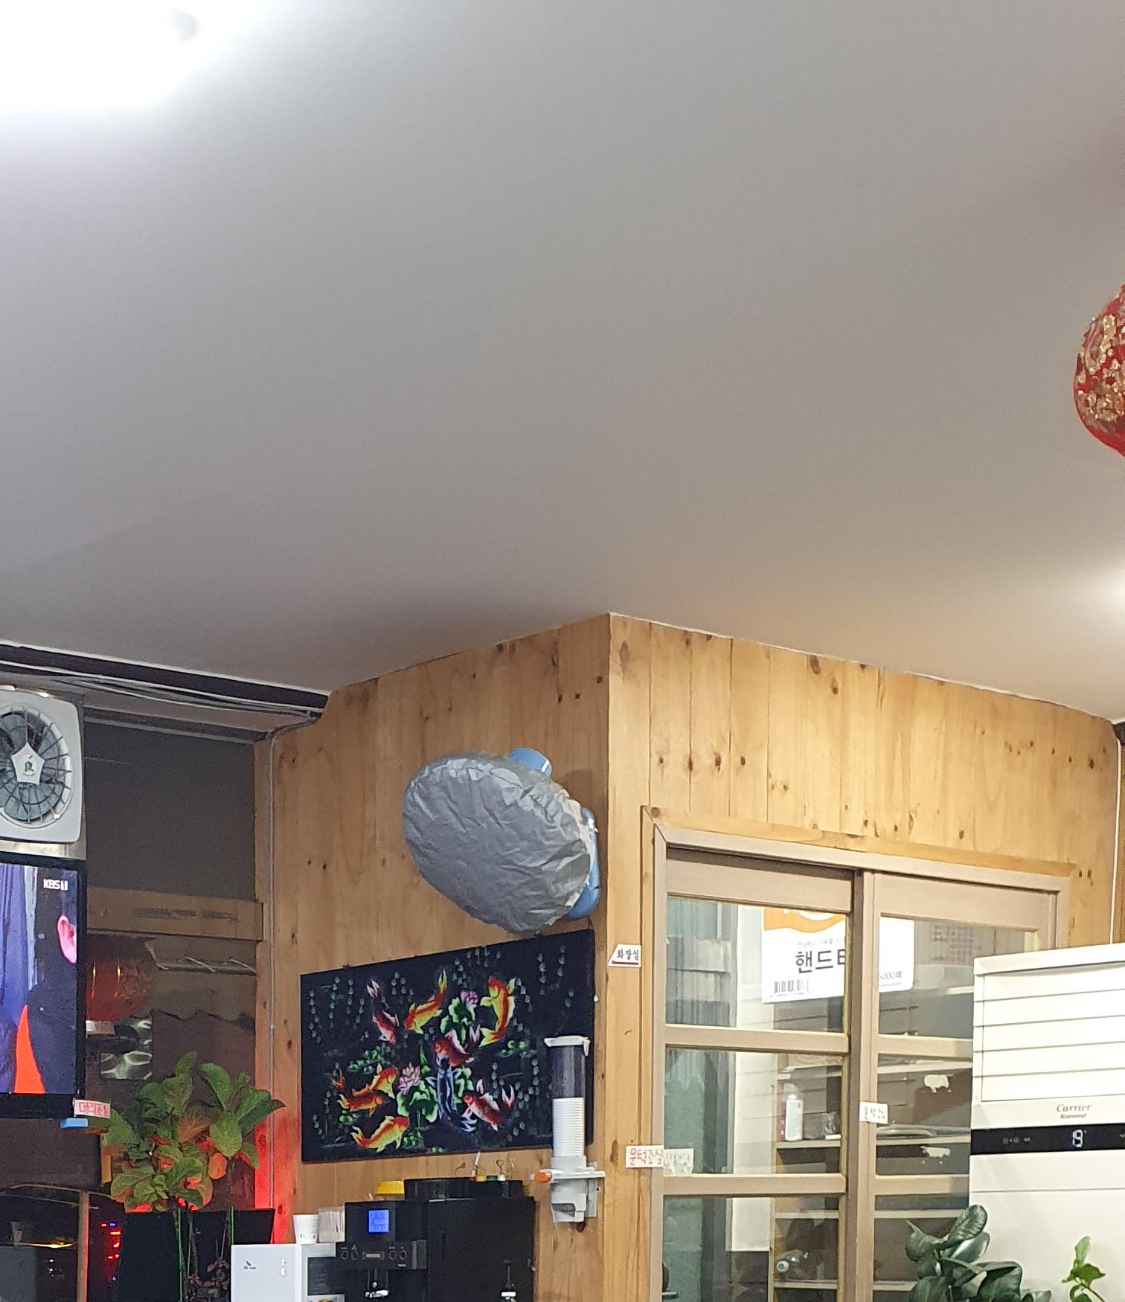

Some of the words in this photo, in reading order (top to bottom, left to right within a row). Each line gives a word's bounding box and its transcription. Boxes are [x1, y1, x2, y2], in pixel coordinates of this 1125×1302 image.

[616, 948, 640, 961] 화장실
[1056, 1103, 1093, 1114] Carrier
[629, 1147, 665, 1167] 문턱조심
